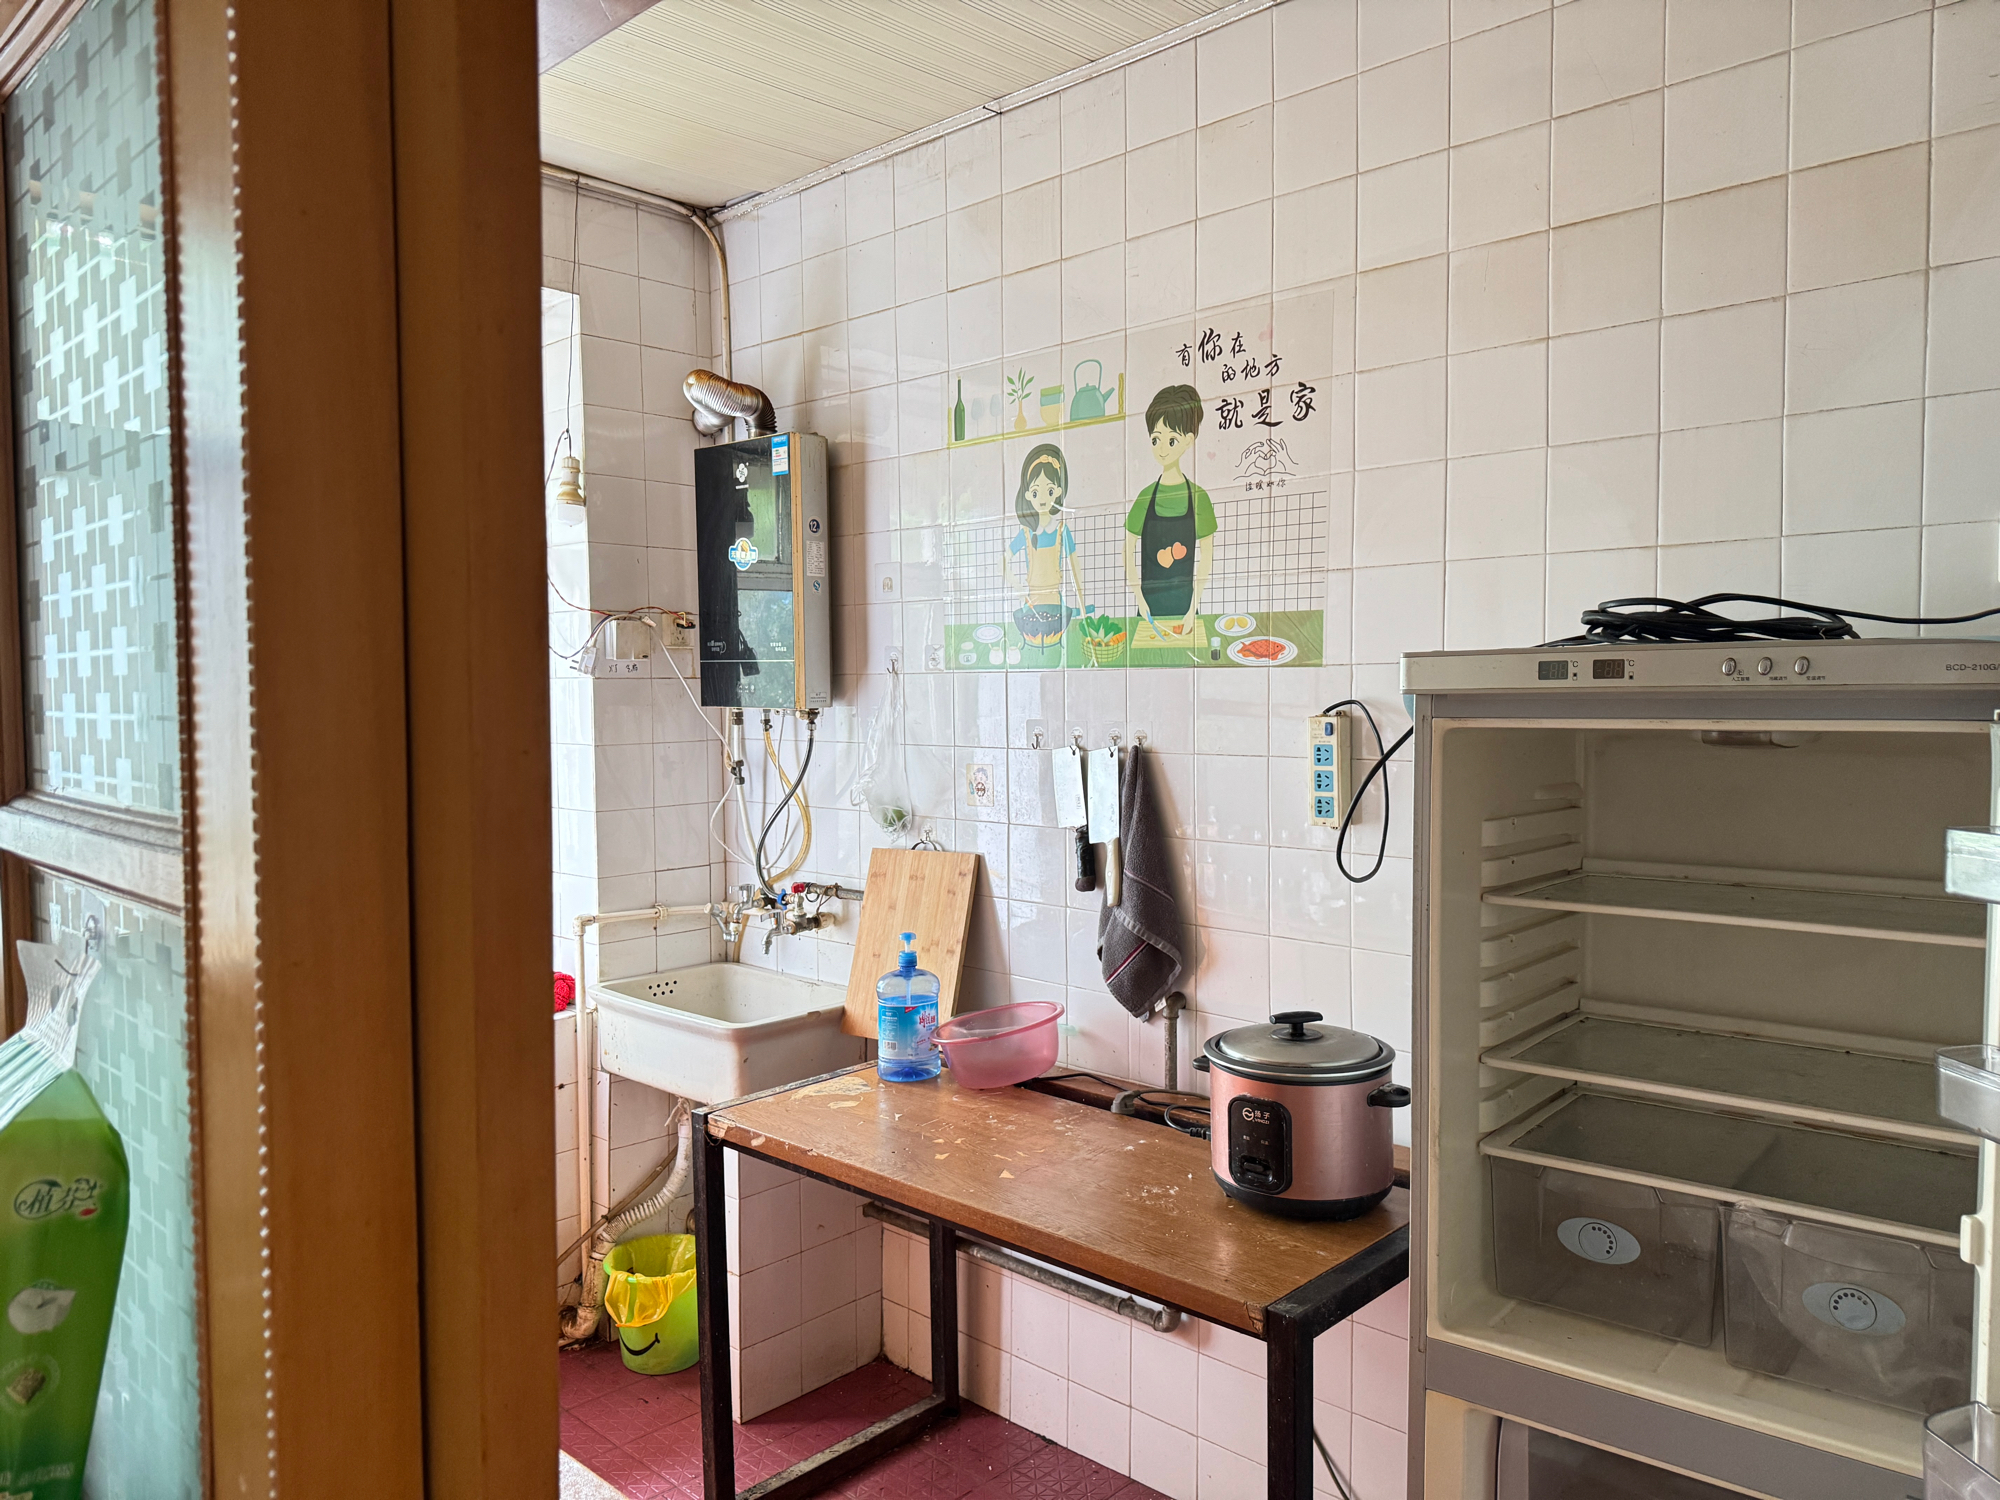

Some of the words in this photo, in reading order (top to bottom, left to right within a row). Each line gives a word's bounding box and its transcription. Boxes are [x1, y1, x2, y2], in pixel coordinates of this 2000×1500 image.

[1175, 327, 1246, 367] 有你在
[1221, 353, 1283, 384] 的地方
[1215, 381, 1317, 430] 就是家
